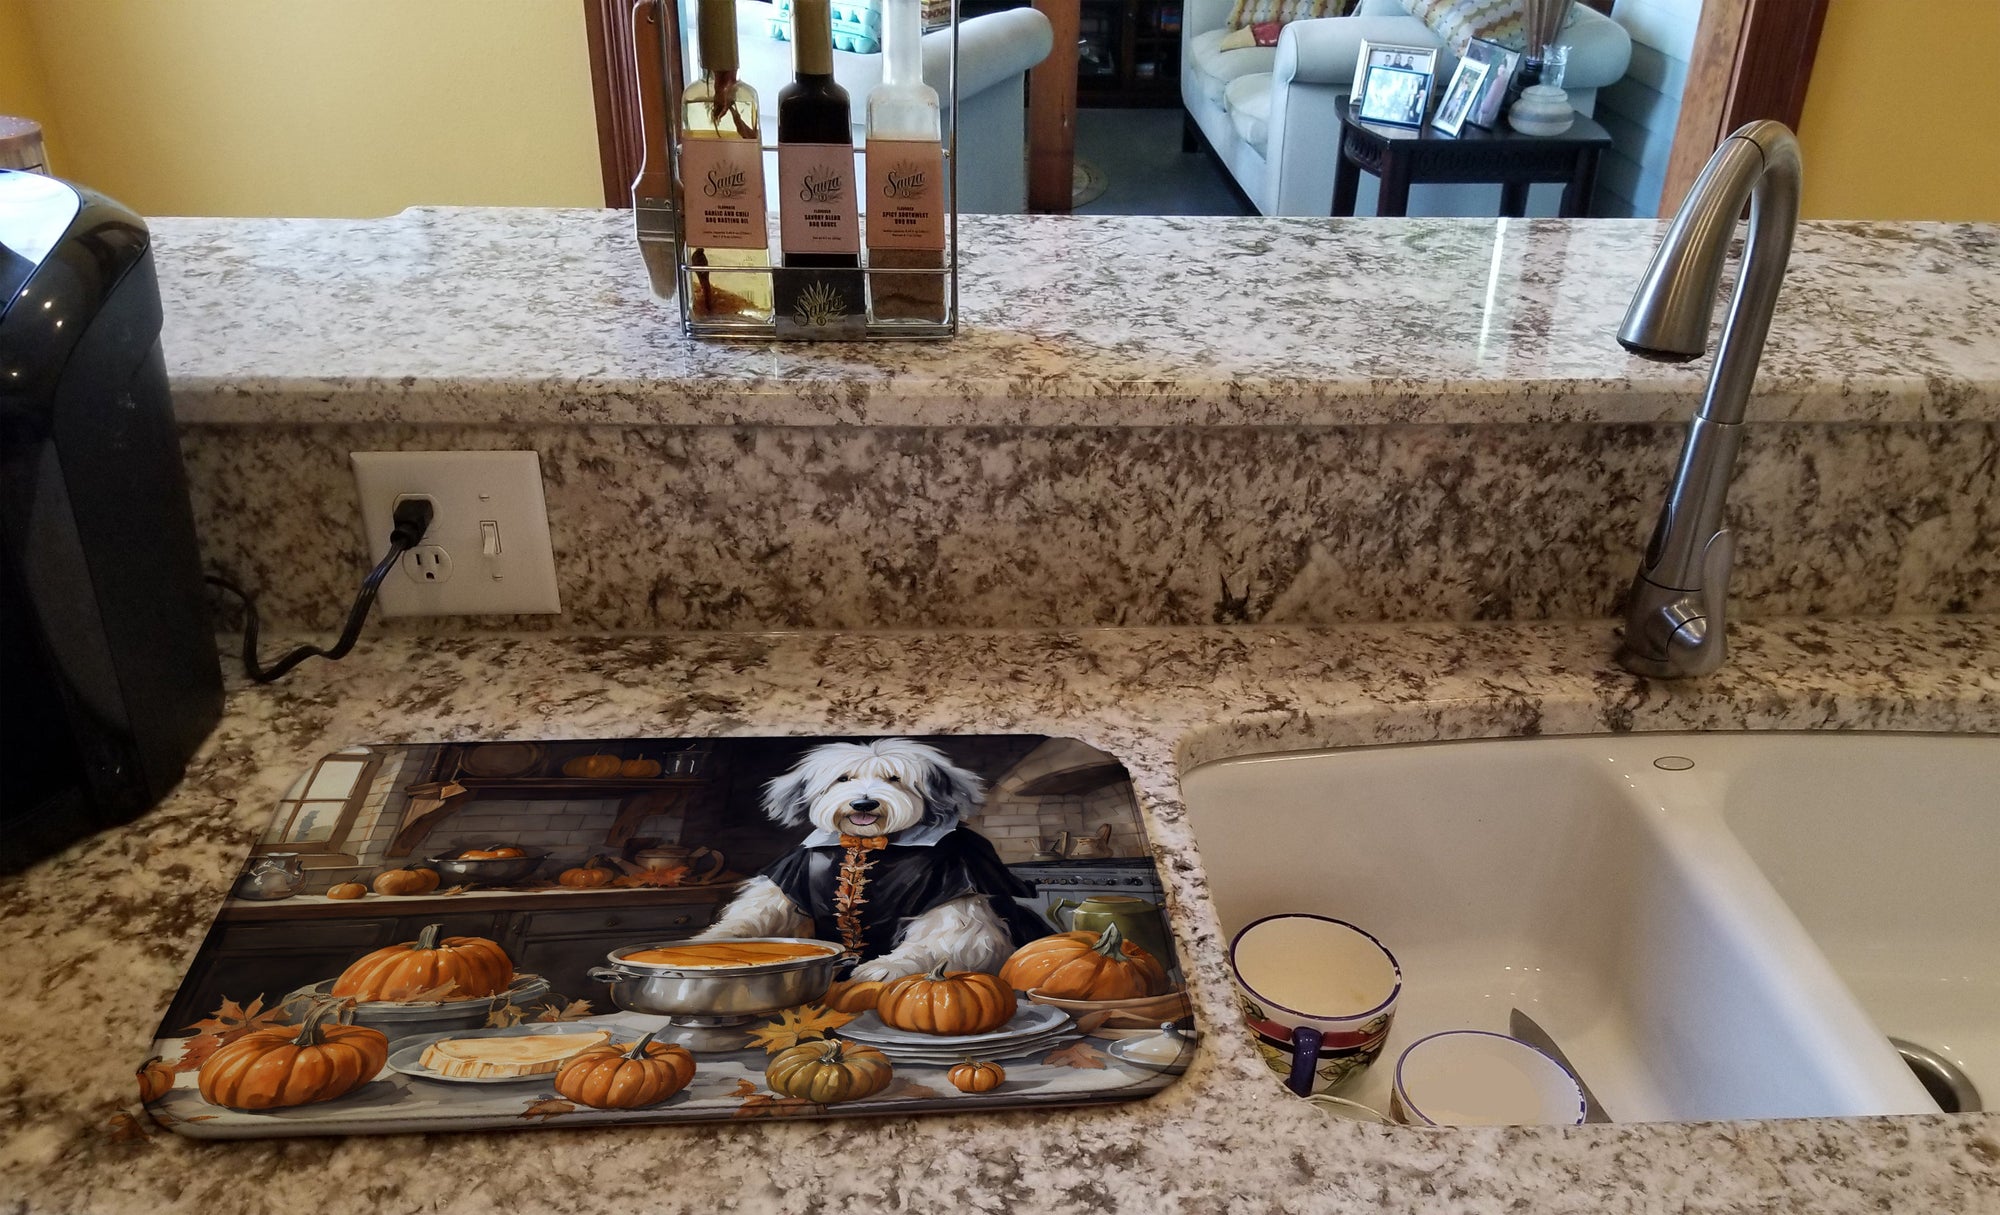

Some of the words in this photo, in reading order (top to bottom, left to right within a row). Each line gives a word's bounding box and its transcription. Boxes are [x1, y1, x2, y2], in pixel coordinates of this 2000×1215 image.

[703, 169, 745, 198] Sauza
[800, 175, 841, 202] Sauza
[883, 170, 925, 199] Sauza
[898, 211, 929, 219] SOUTHWEST
